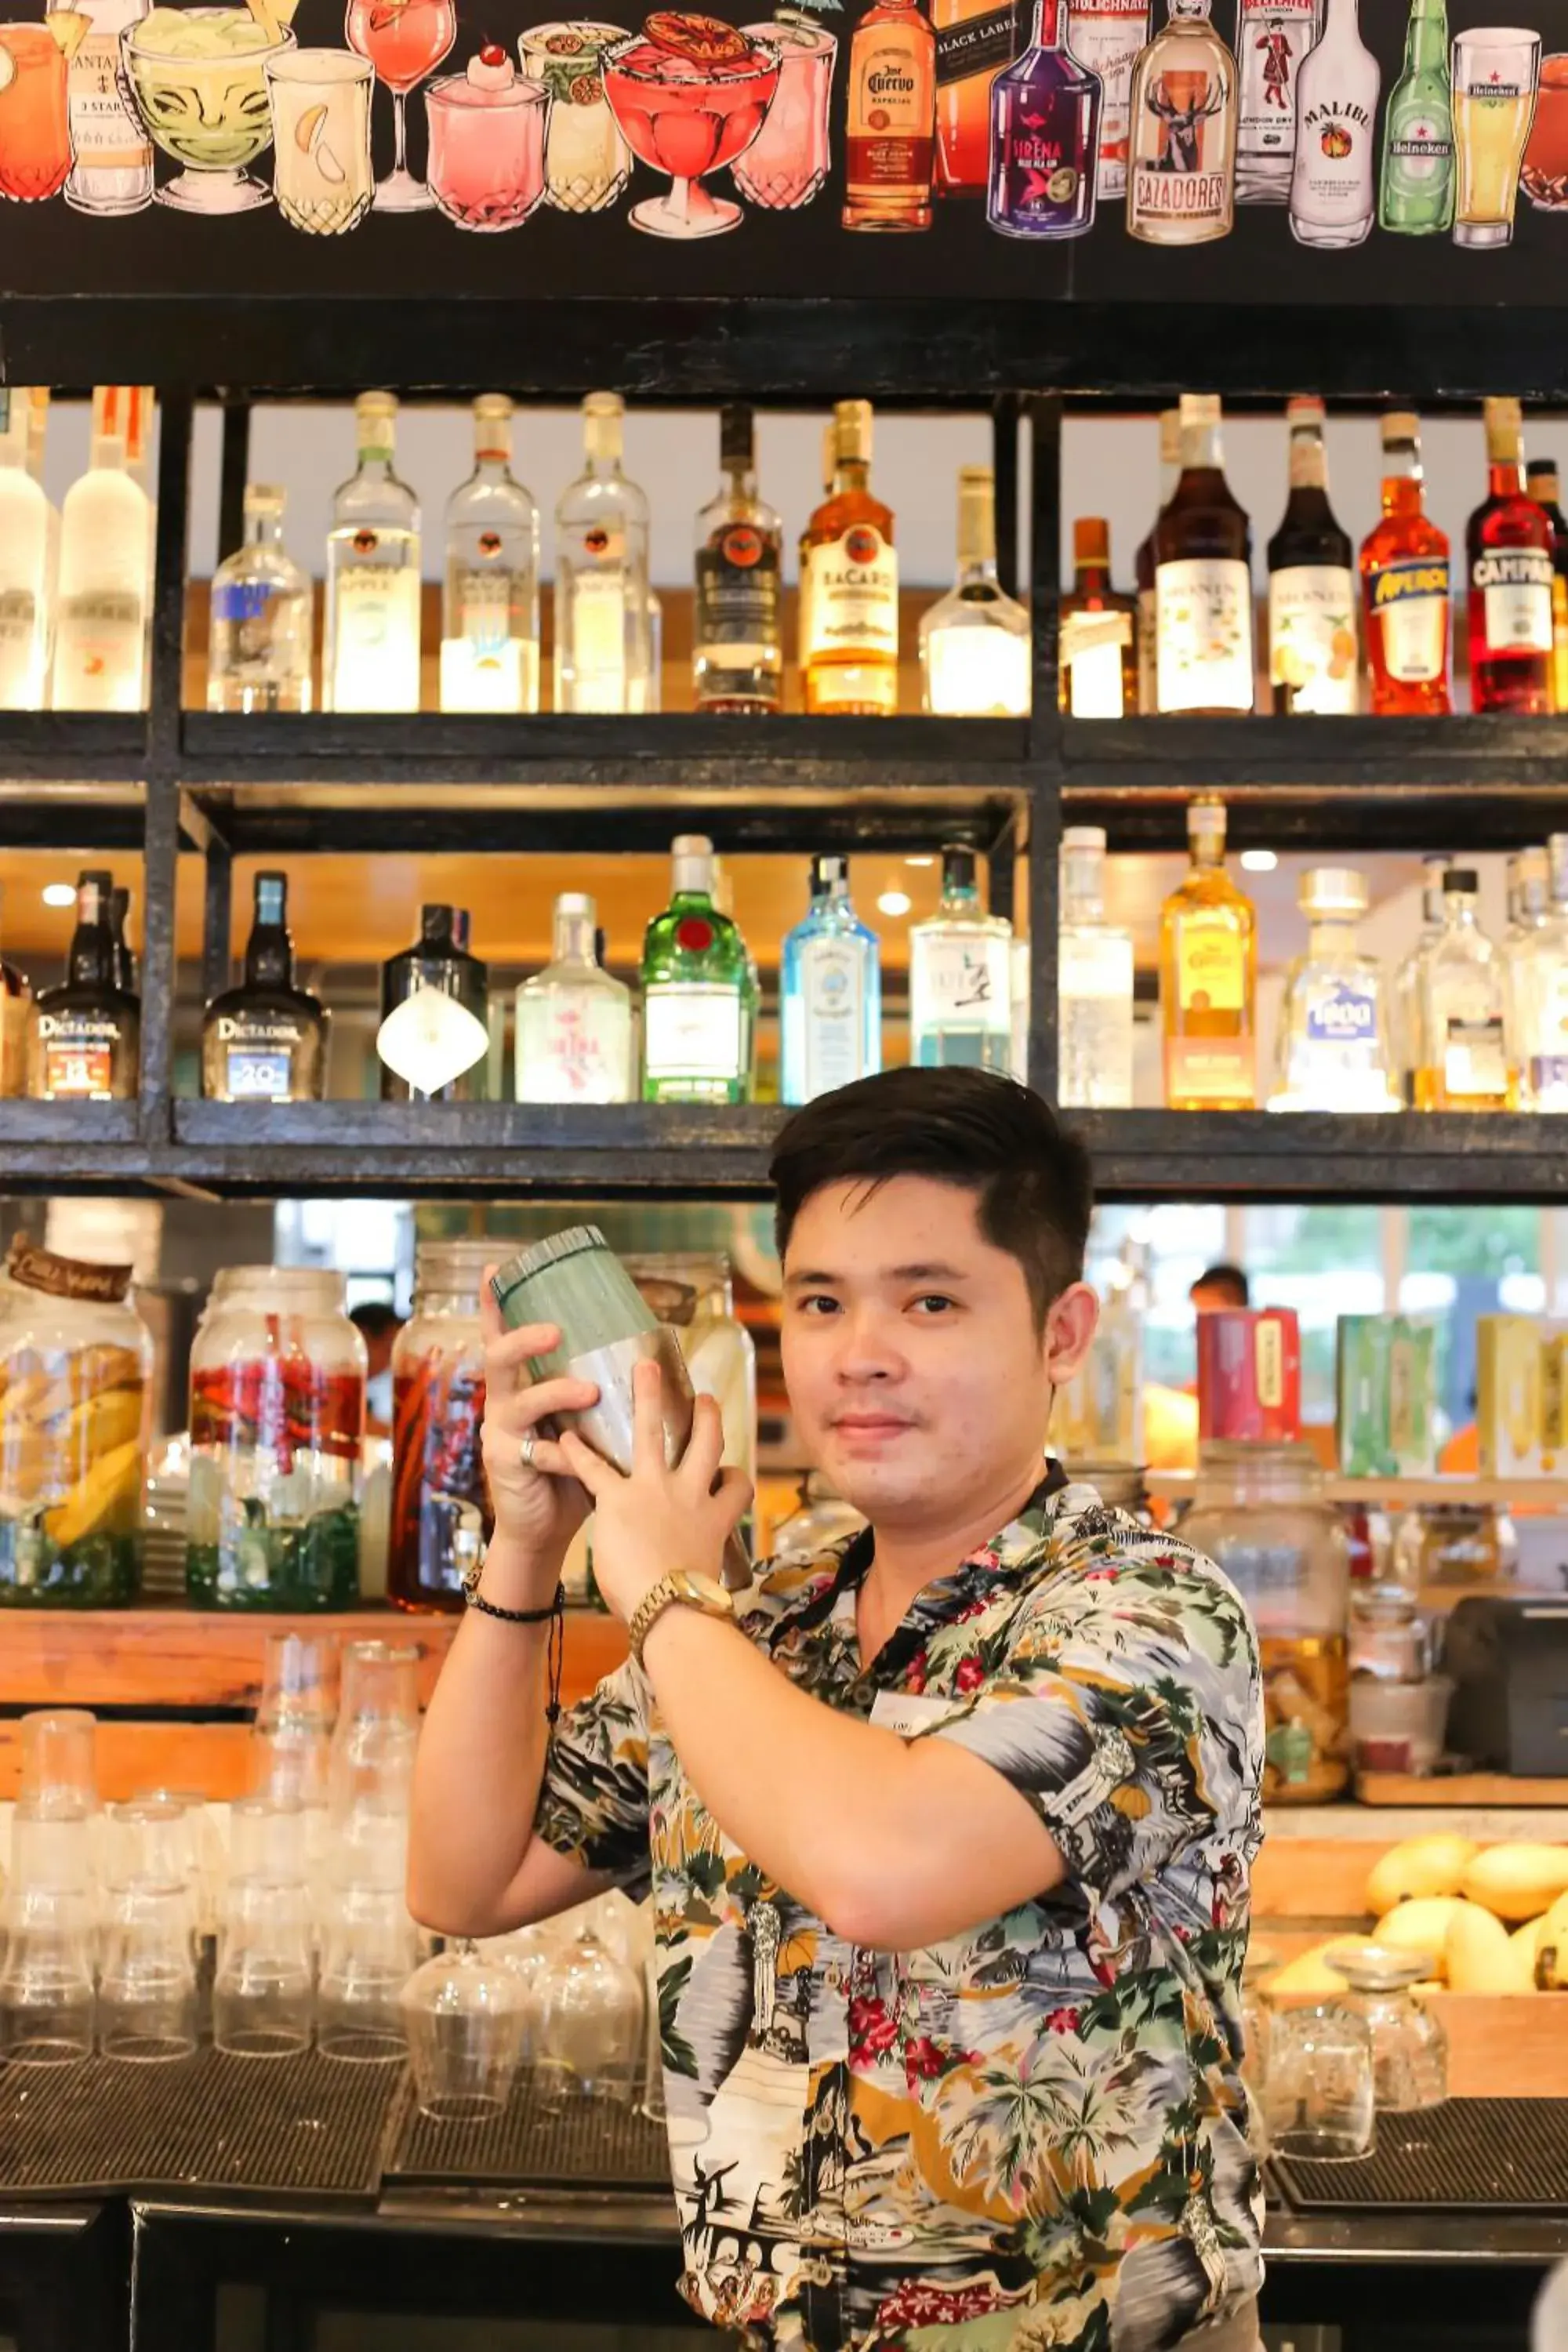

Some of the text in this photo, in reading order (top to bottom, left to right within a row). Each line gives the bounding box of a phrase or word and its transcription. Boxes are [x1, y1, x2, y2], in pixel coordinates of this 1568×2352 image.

[978, 16, 1018, 38] LABEL
[867, 71, 914, 94] Cuervo
[1472, 85, 1517, 96] Heineken
[91, 102, 124, 111] STAR
[1304, 103, 1372, 131] MALIBU
[1392, 138, 1449, 154] Heineken
[1138, 176, 1223, 209] CAZADORES
[1473, 557, 1554, 586] CAMPAR
[1374, 566, 1449, 606] APERO
